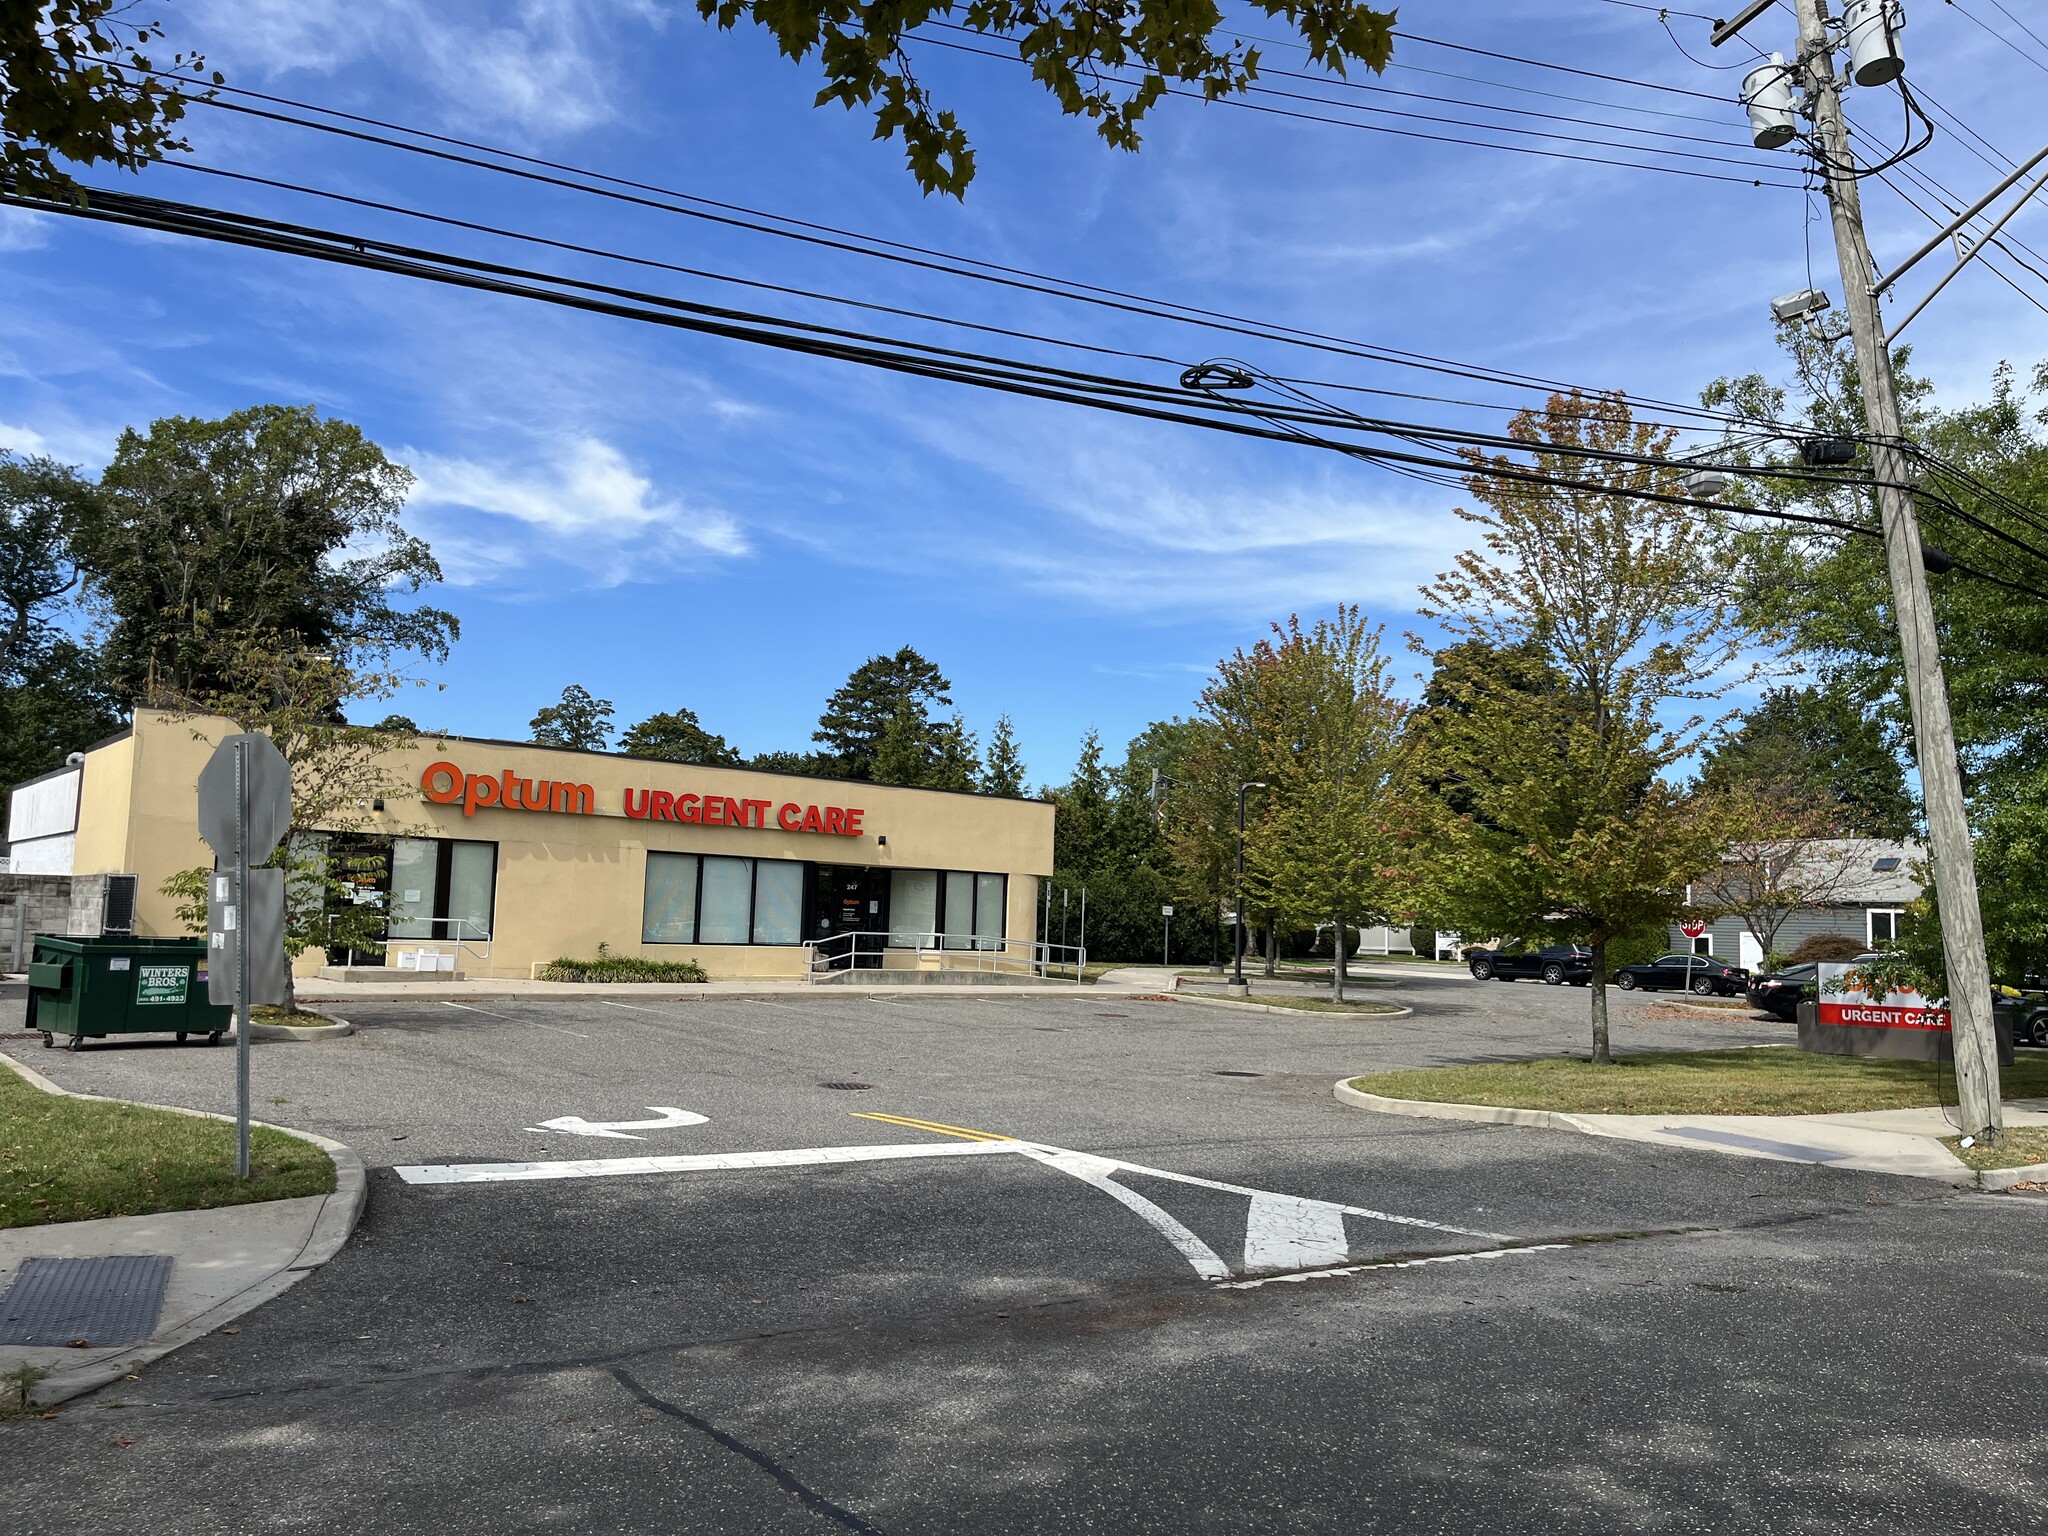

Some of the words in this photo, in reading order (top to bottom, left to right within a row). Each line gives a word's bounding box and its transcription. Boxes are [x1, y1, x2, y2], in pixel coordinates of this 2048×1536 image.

[421, 761, 595, 817] Optum
[623, 787, 772, 828] URGENT
[777, 802, 865, 836] CARE
[141, 968, 188, 978] WINTERS
[147, 977, 179, 987] BROS.
[1841, 1009, 1902, 1024] URGENT
